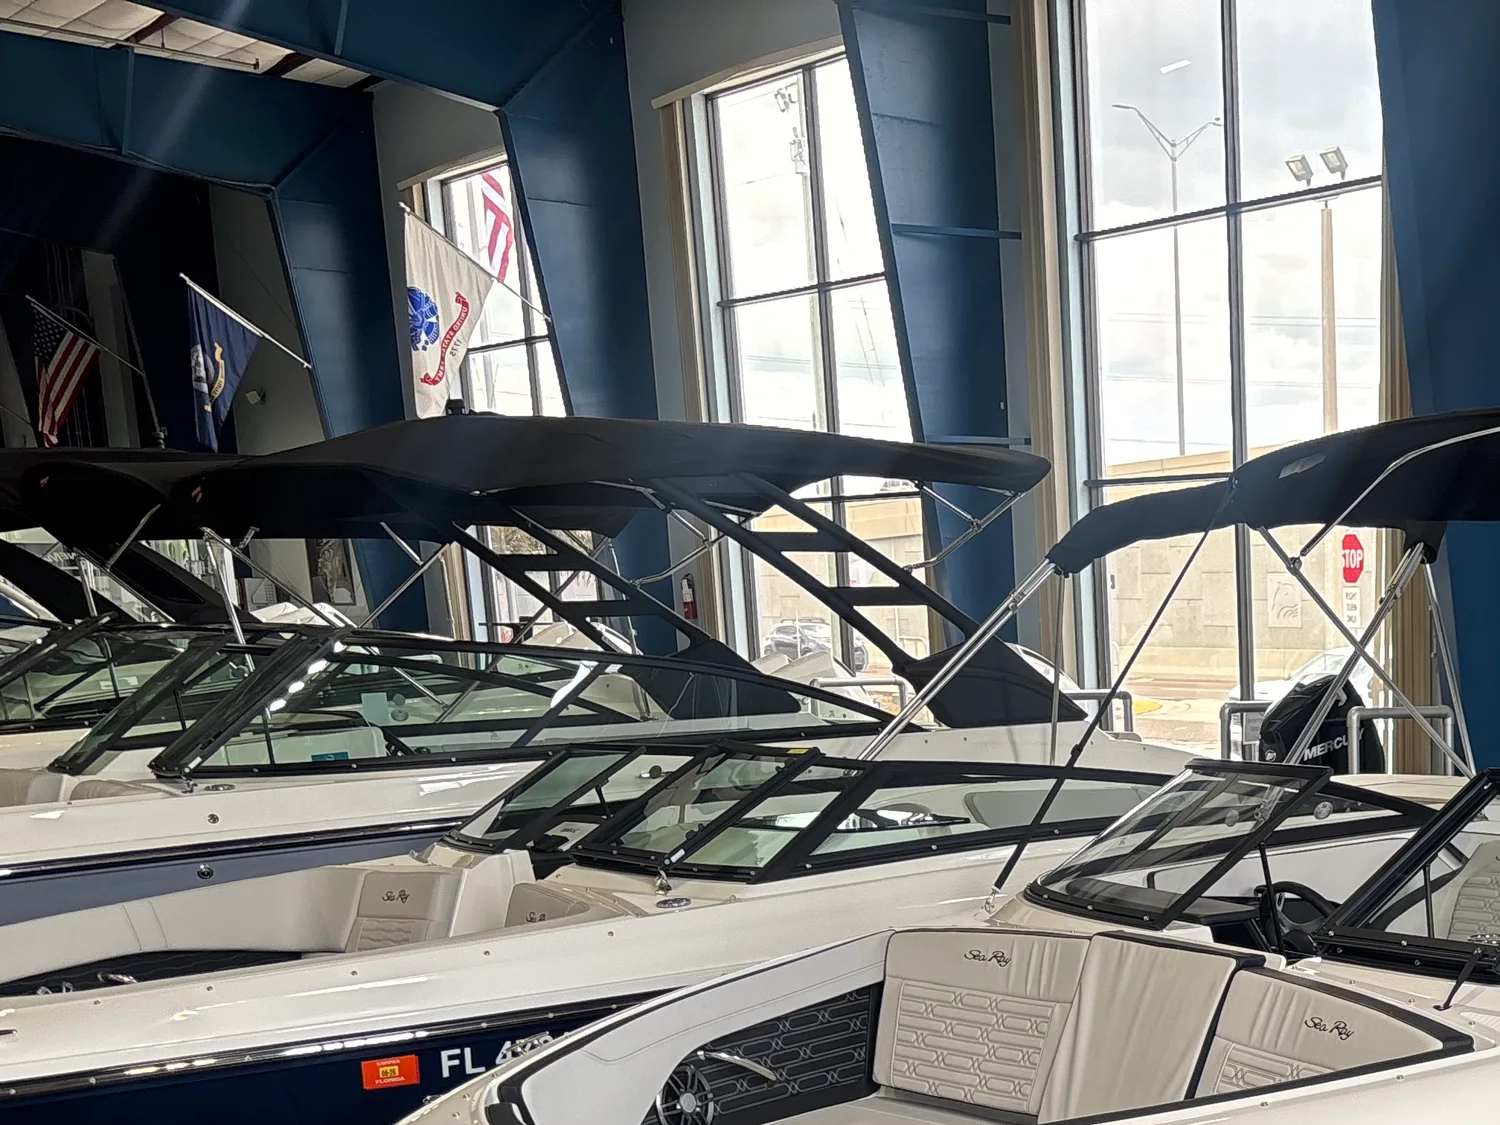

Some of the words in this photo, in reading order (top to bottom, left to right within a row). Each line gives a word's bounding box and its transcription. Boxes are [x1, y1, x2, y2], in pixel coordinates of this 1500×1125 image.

[1341, 548, 1363, 569] STOP
[1303, 727, 1365, 762] MERCUY
[964, 949, 988, 962] Sea
[988, 950, 1011, 967] Ray
[1304, 1016, 1329, 1032] Sea
[1329, 1020, 1355, 1041] Ray
[440, 1047, 486, 1078] FL
